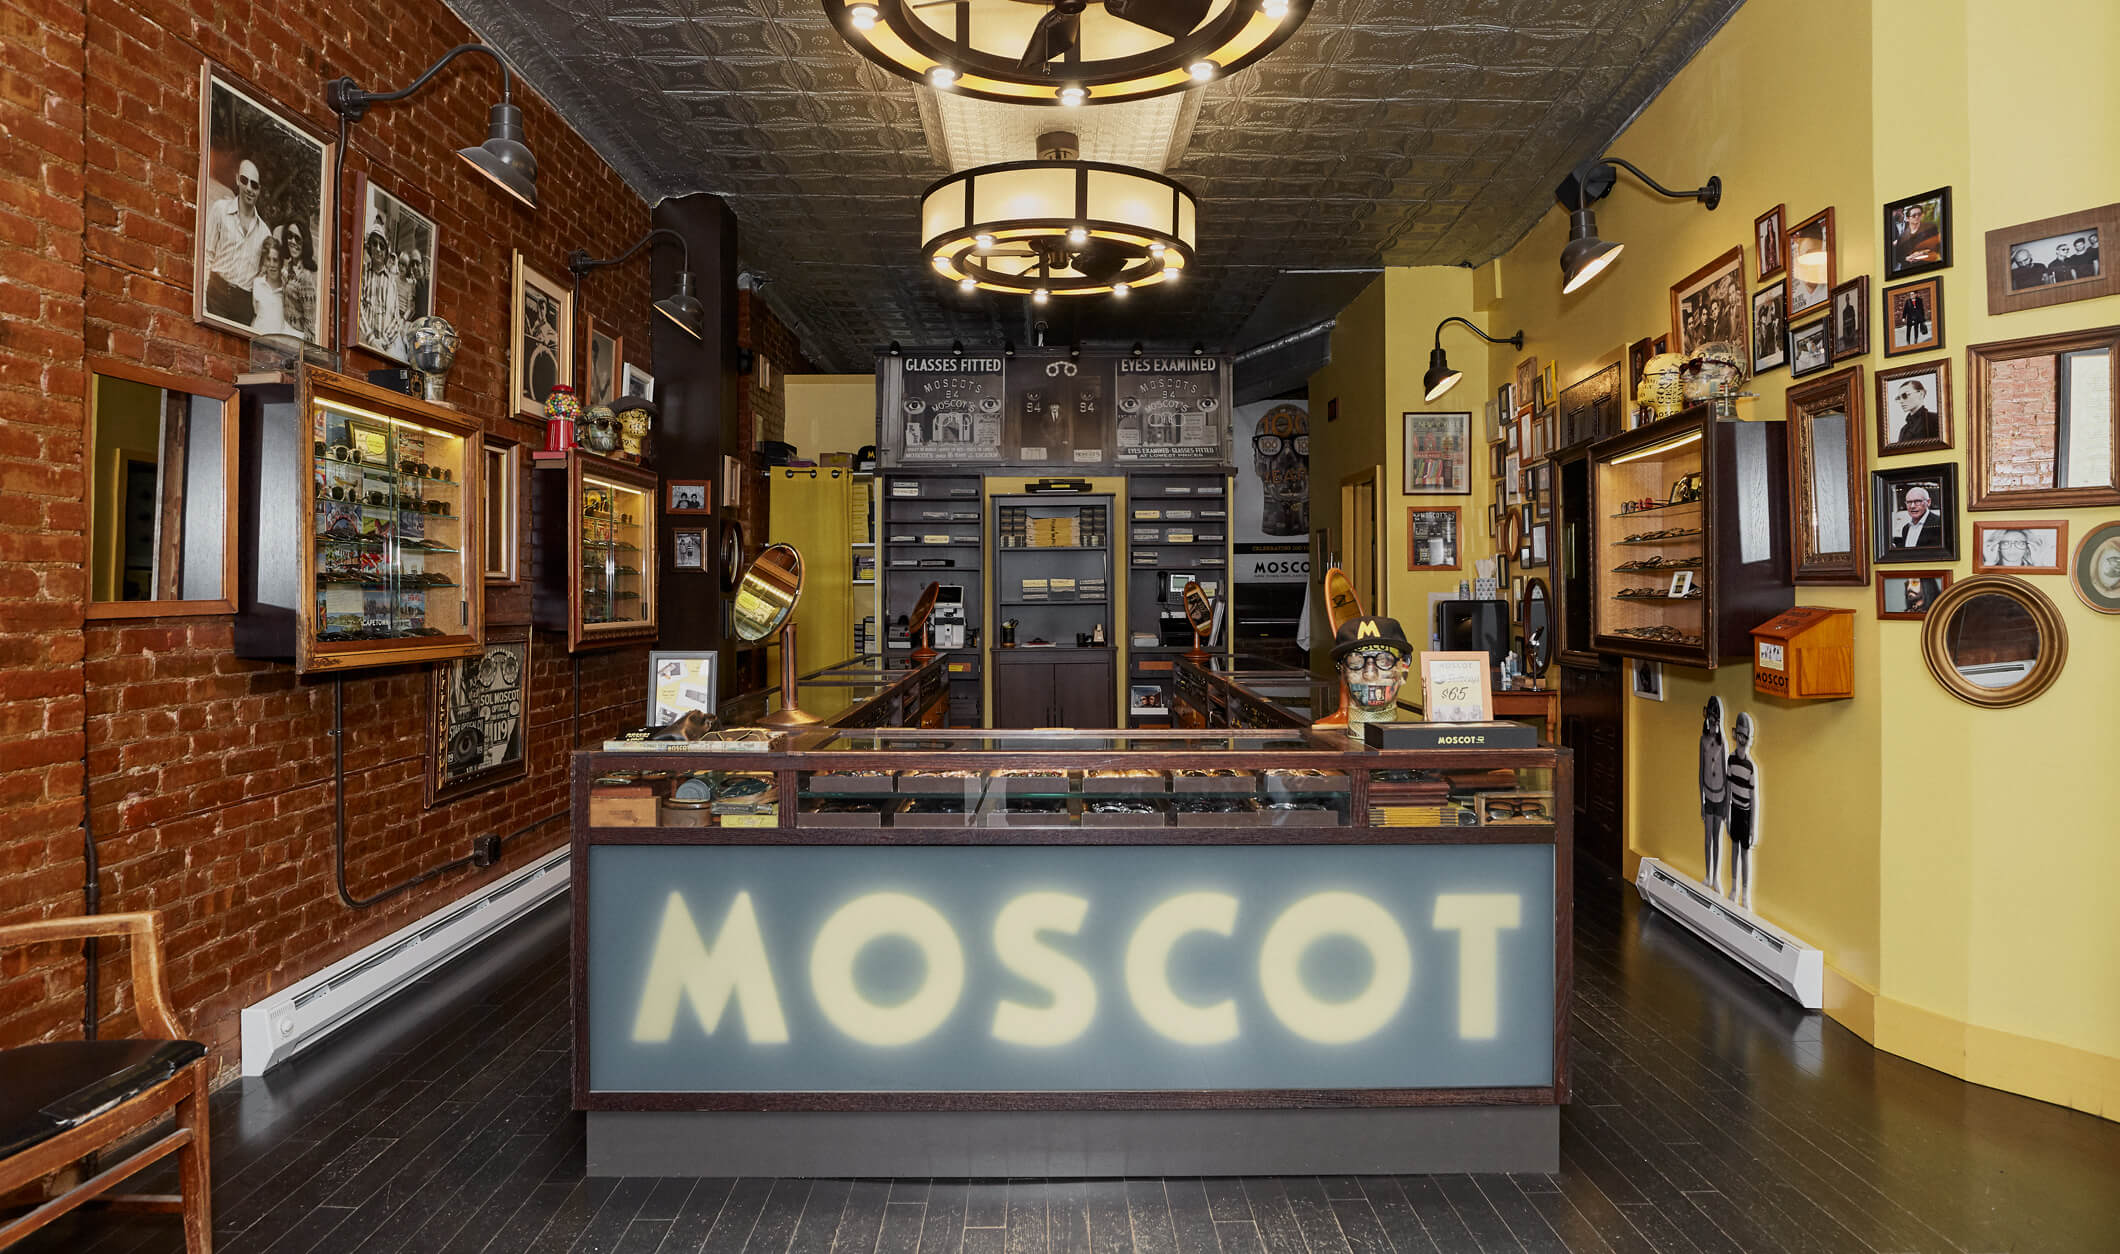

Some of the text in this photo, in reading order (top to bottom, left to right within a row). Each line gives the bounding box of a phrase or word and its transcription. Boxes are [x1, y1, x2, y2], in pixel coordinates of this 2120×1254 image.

[905, 358, 1001, 371] GLASSES FITTED
[1121, 358, 1216, 371] EYES EXAMINED
[867, 450, 876, 459] M
[1357, 620, 1381, 640] M
[1756, 671, 1789, 689] MOSCOT
[480, 689, 519, 706] SOL MOSCOT
[1440, 686, 1469, 701] $65
[1438, 736, 1475, 744] MOSCOT
[632, 890, 1523, 1048] MOSCOT
